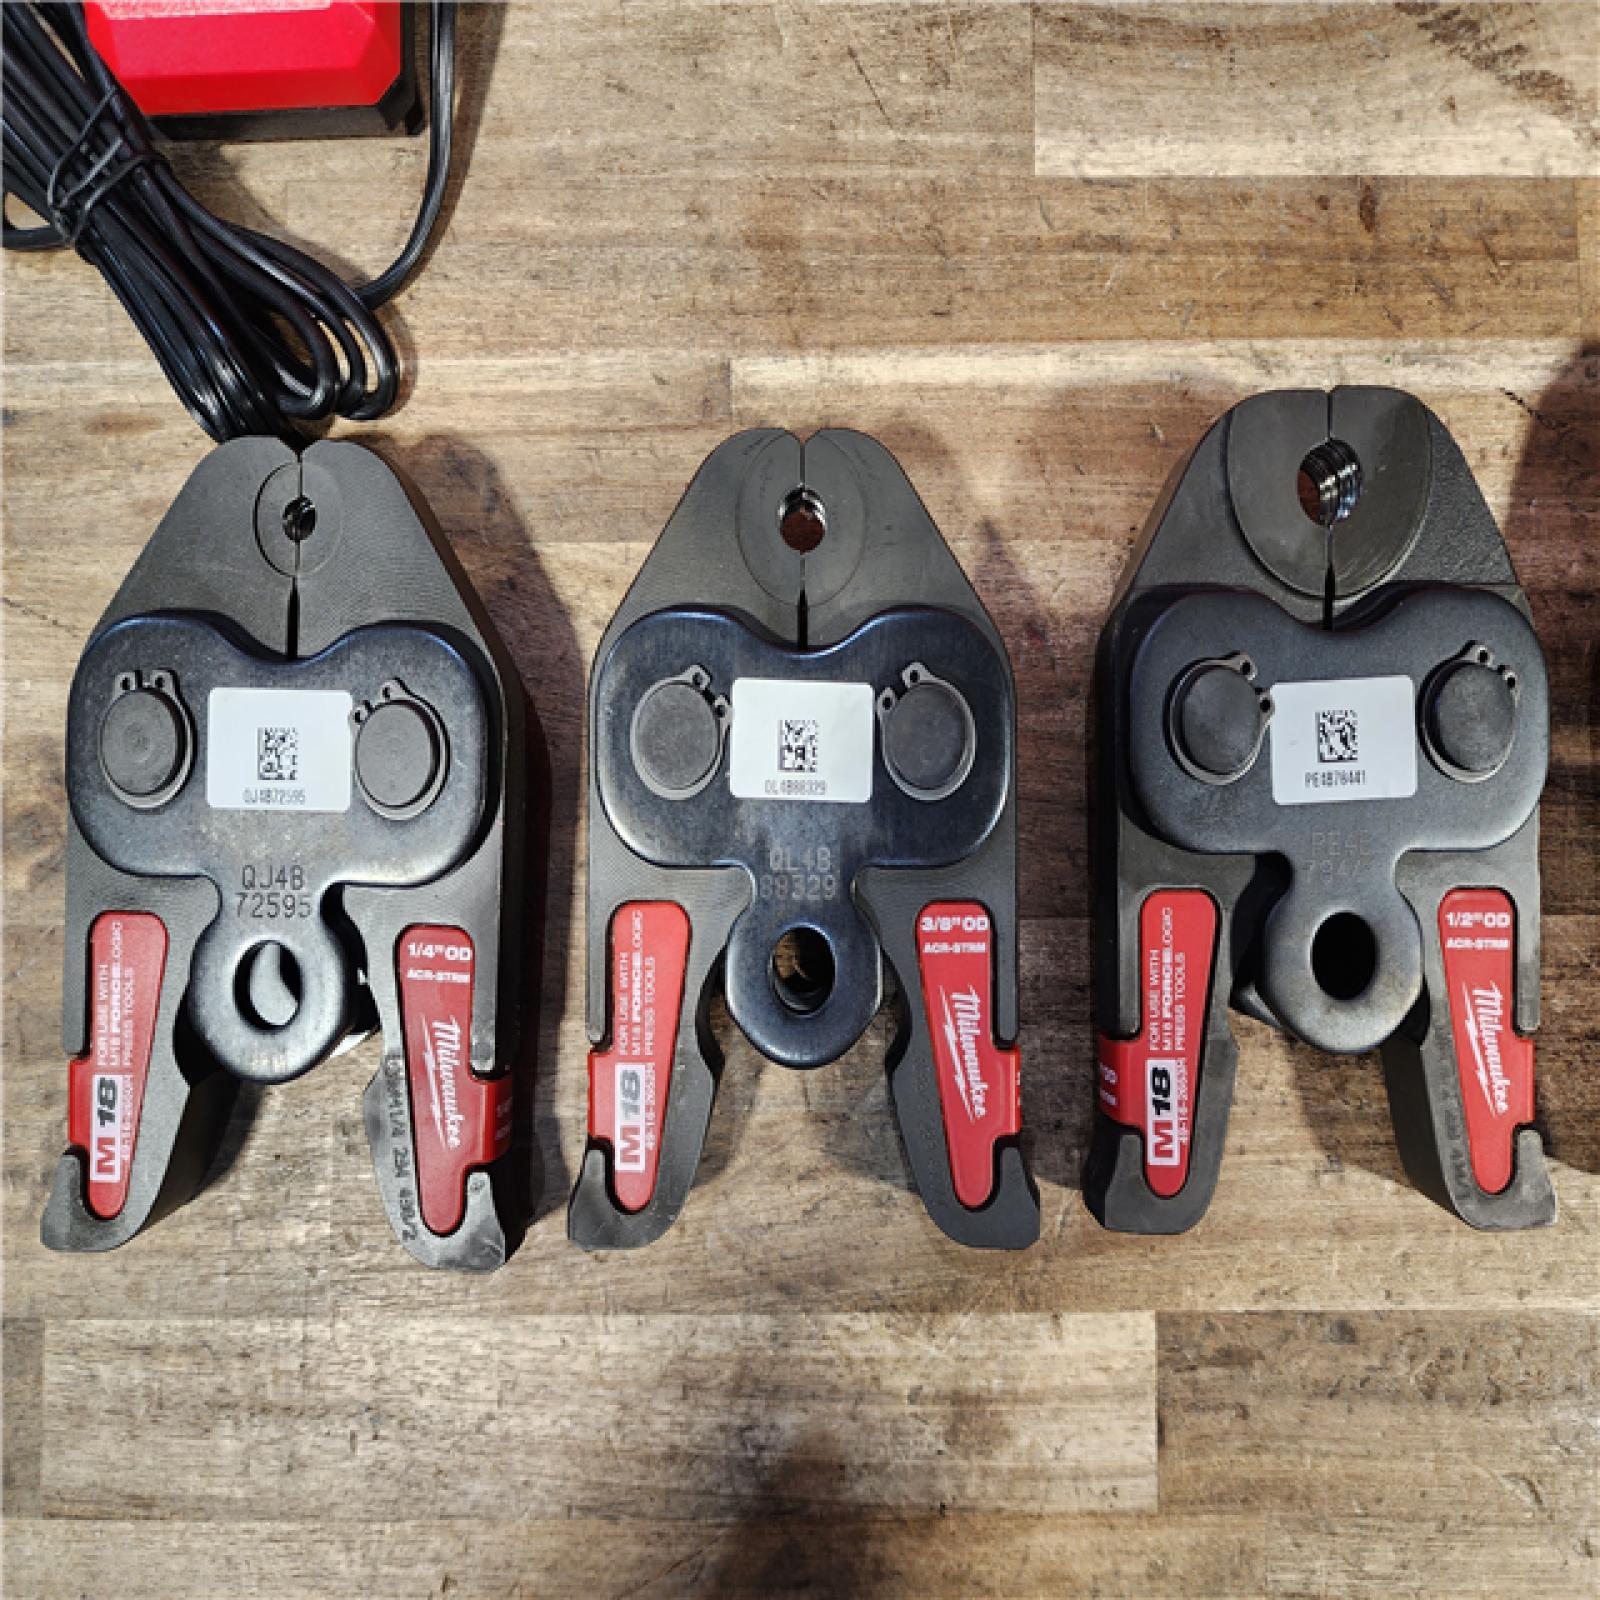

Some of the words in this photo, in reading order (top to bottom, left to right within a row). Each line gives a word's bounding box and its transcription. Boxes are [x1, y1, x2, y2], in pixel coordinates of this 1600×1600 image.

[235, 892, 312, 919] 72595
[241, 864, 304, 891] QJ4B
[431, 1014, 465, 1148] Milwaukee
[950, 982, 989, 1119] Milwaukee
[1471, 980, 1512, 1115] Milwaukee
